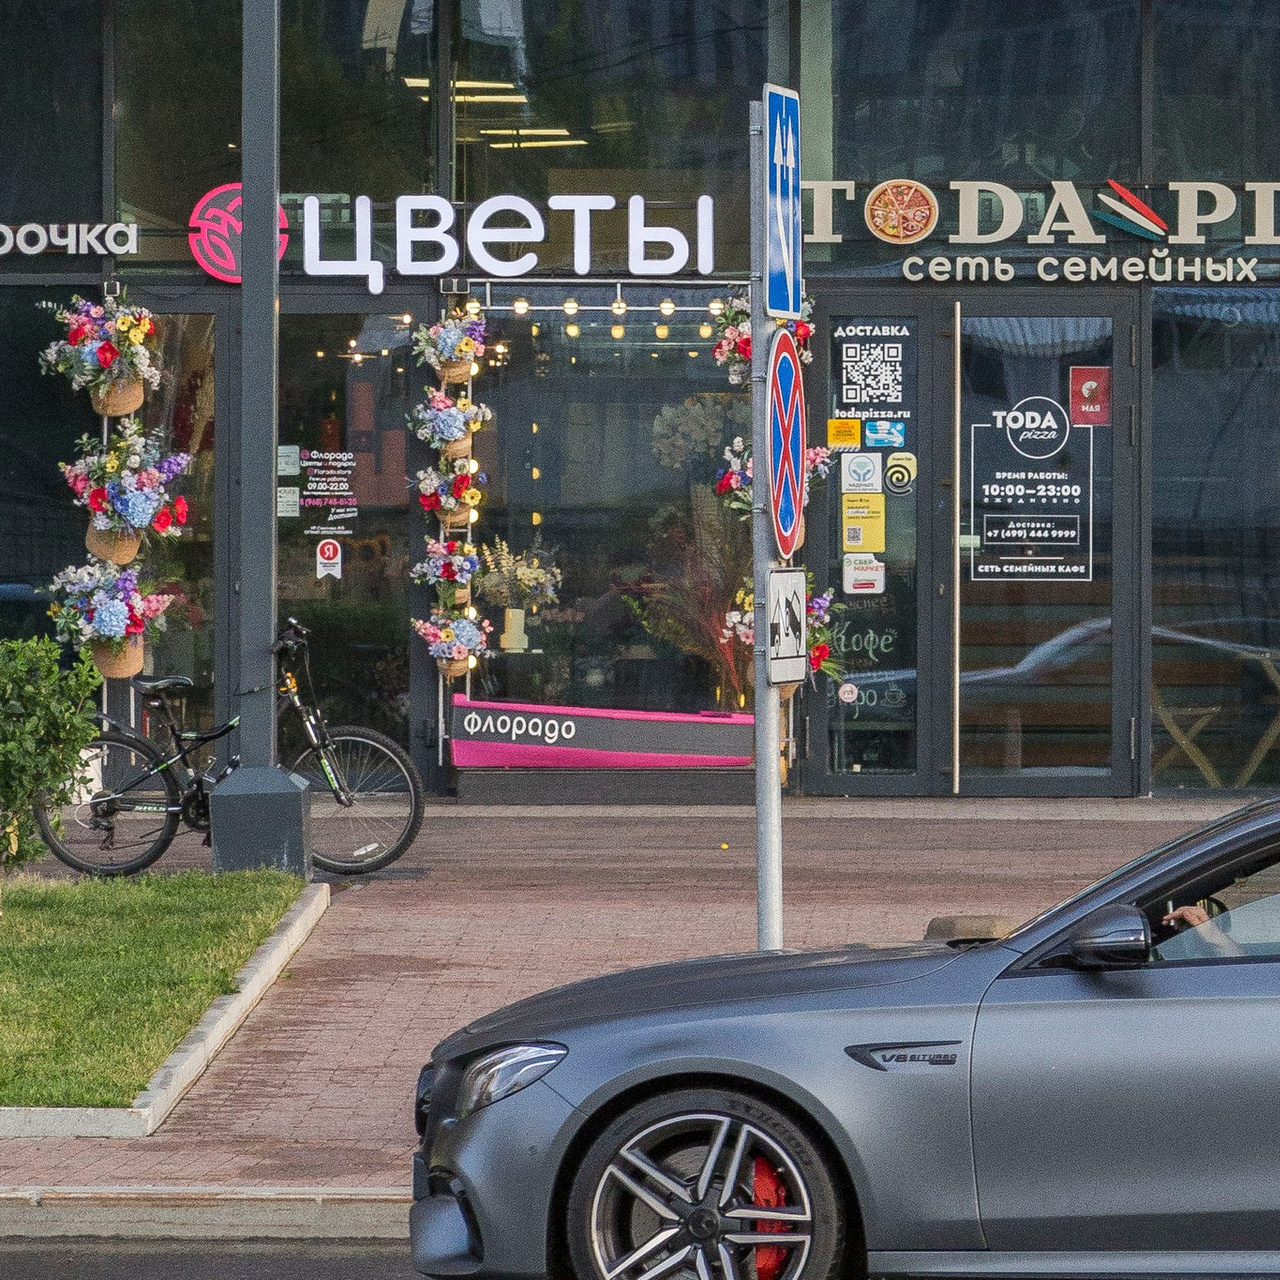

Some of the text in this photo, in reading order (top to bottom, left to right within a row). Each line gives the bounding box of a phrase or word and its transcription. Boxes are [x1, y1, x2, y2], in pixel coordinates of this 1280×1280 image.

[902, 256, 1015, 282] сеть
[1037, 248, 1259, 283] семейных
[833, 325, 910, 338] ДОСТАВКА
[834, 407, 911, 421] todapizza.ru
[992, 410, 1059, 430] TODA
[1019, 429, 1058, 442] pizza
[995, 472, 1068, 480] ВРЕМЯ РАБОТЫ:
[307, 482, 349, 491] 09.00-22.00
[1008, 521, 1055, 529] Доставка:
[986, 530, 999, 538] +7
[1001, 529, 1027, 539] (499)
[977, 563, 1086, 573] СЕТЬ СЕМЕЙНЫХ КАФЕ
